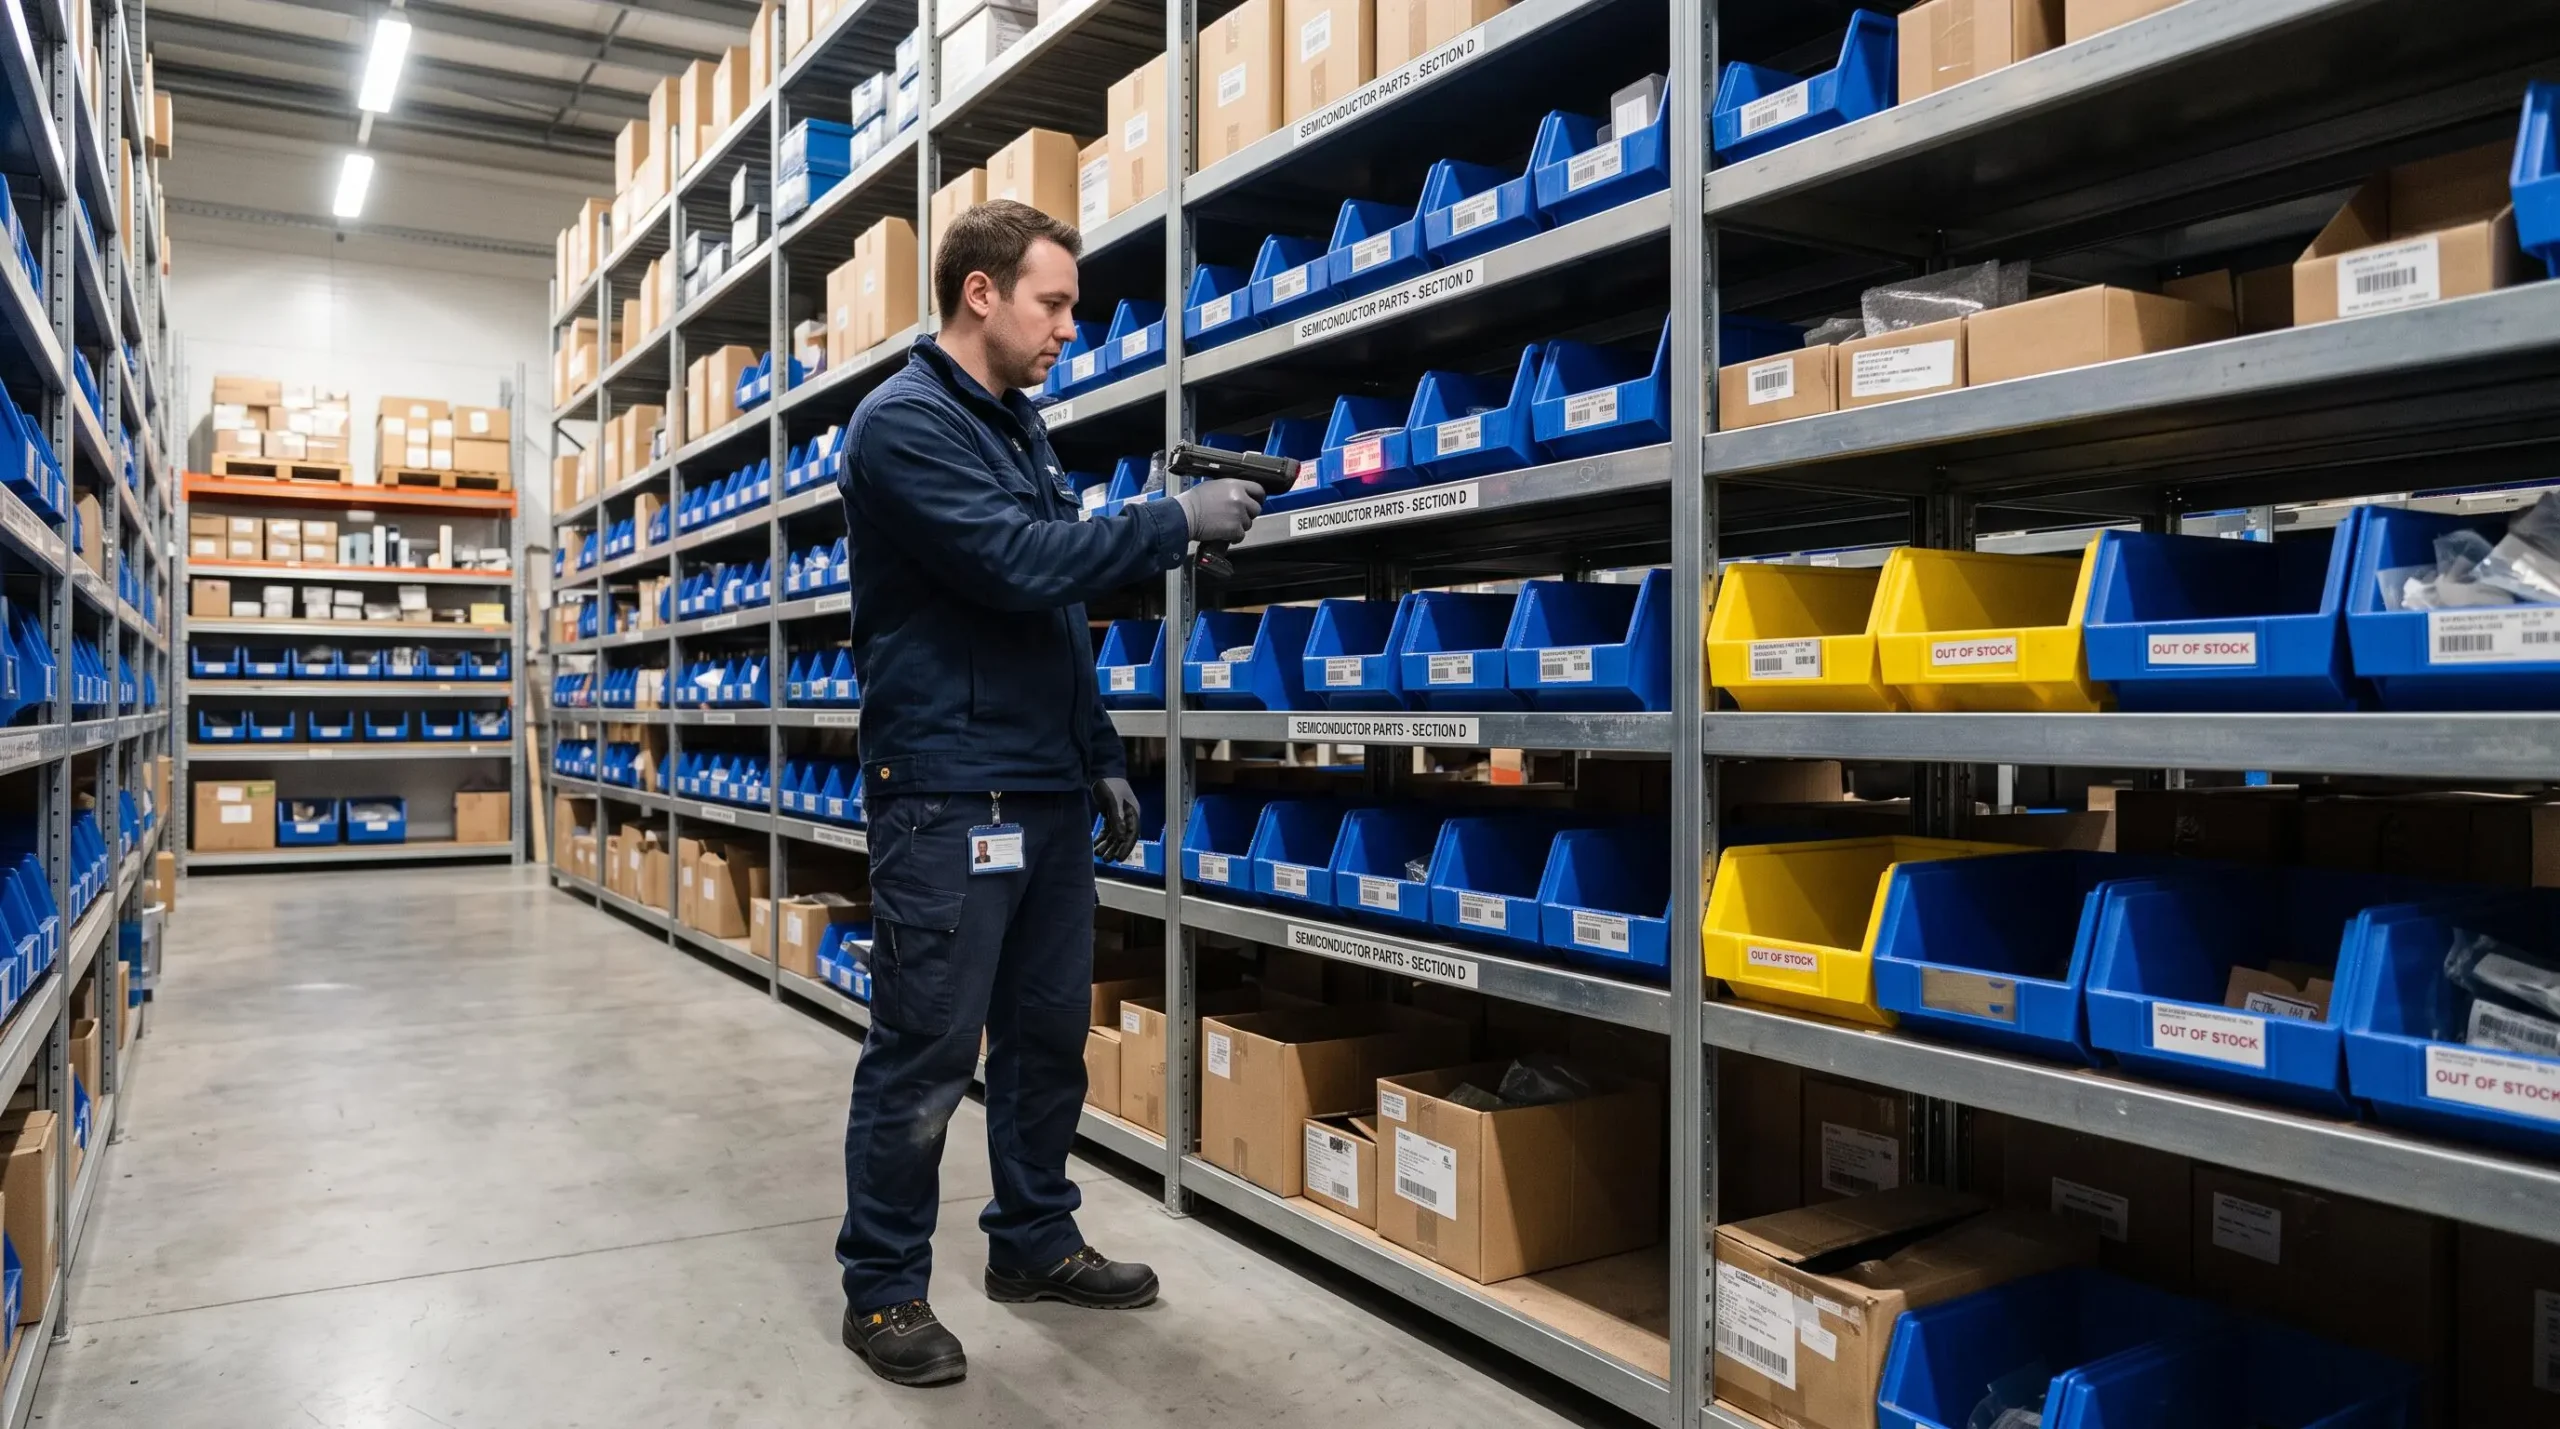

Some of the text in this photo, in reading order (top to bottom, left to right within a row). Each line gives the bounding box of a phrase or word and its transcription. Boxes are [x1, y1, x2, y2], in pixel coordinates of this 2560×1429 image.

[1301, 89, 1377, 138] SEMICONDUCTOR
[1379, 72, 1410, 98] PARTS
[1419, 43, 1464, 78] SECTION
[1467, 39, 1475, 54] D
[1302, 302, 1376, 338] SEMICONDUCTOR
[1379, 290, 1409, 312] PARTS
[1418, 272, 1463, 299] SECTION
[1466, 269, 1473, 284] D
[1298, 507, 1372, 531] SEMICONDUCTOR
[1374, 500, 1404, 518] PARTS
[1412, 491, 1456, 512] SECTION
[1459, 490, 1467, 504] D
[1935, 644, 2013, 659] OUT OF STOCK
[2152, 642, 2249, 655] OUT OF STOCK
[1296, 721, 1371, 735] SEMICONDUCTOR
[1373, 723, 1404, 736] PARTS
[1412, 723, 1456, 737] SECTION
[1459, 724, 1466, 737] D
[1295, 931, 1371, 959] SEMICONDUCTOR
[1373, 947, 1404, 966] PARTS
[1411, 955, 1455, 978] SECTION
[1458, 965, 1466, 980] D
[1751, 950, 1813, 966] OUT OF STOCK
[2160, 1024, 2258, 1050] OUT OF STOCK
[2435, 1069, 2470, 1086] OUT
[2474, 1076, 2498, 1090] OF
